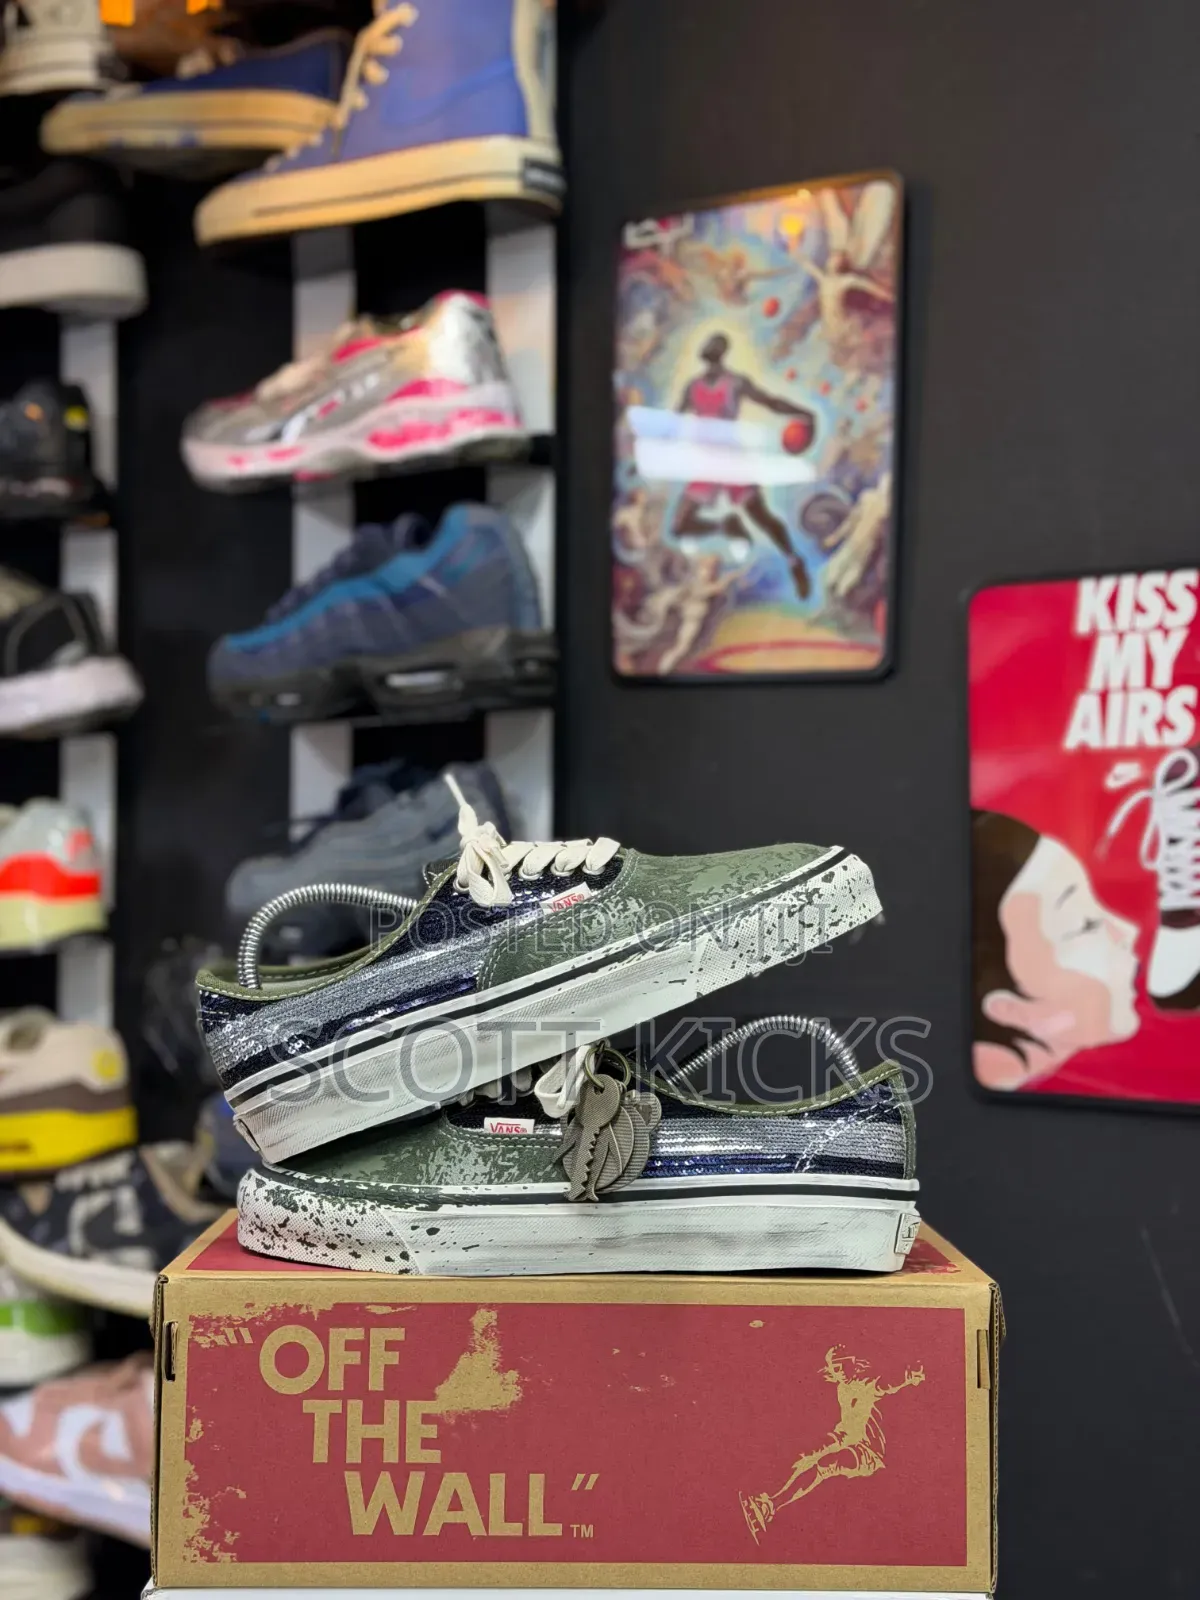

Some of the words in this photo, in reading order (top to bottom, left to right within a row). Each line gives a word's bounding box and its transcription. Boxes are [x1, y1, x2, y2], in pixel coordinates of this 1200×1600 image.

[1075, 568, 1199, 636] KISS
[1087, 627, 1190, 691] MY
[1063, 685, 1198, 750] AIRS
[302, 1400, 442, 1464] THE
